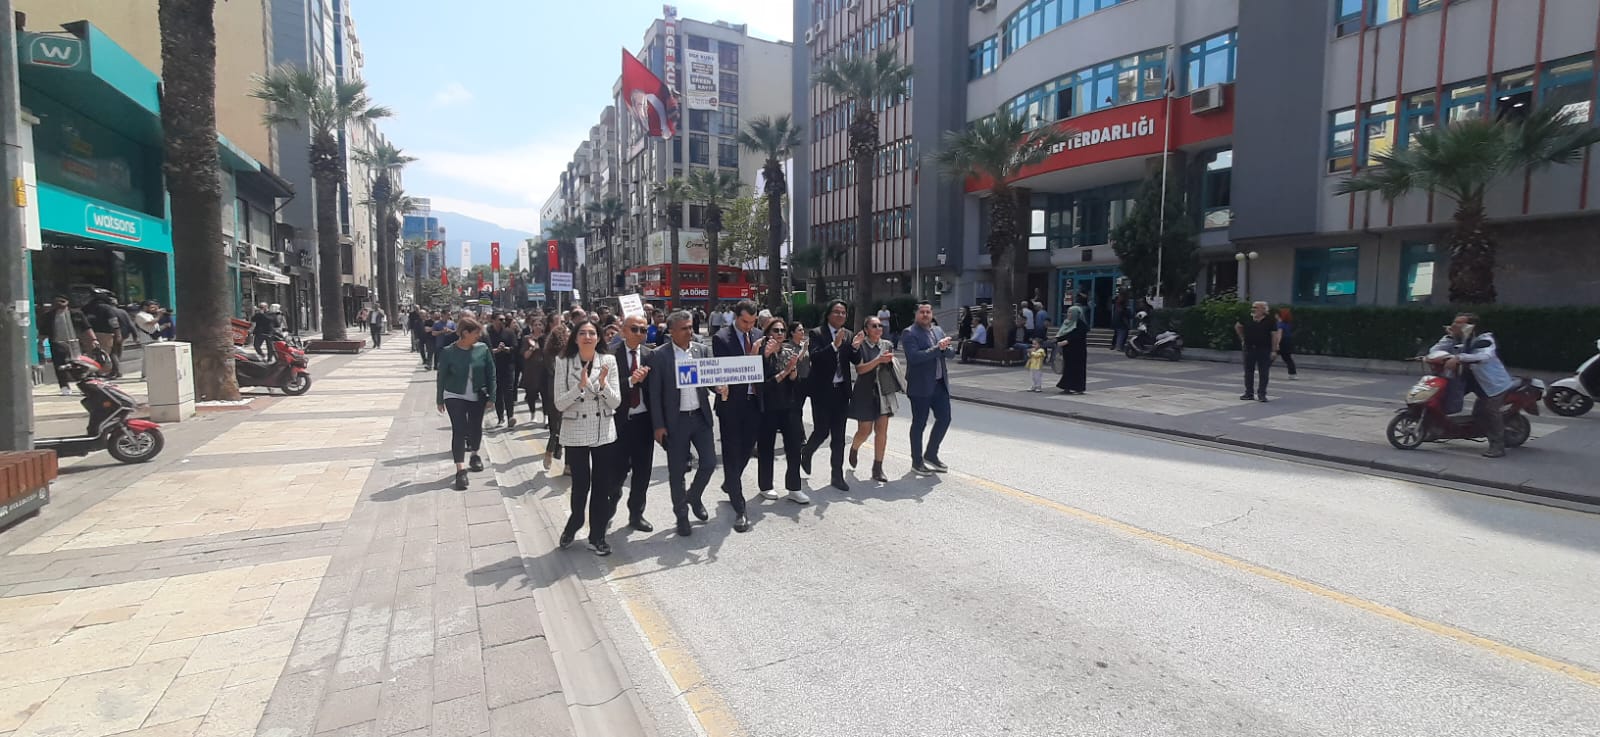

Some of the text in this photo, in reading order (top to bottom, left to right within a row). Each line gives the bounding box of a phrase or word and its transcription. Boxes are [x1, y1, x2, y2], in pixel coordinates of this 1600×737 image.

[665, 26, 676, 57] EGE
[93, 212, 136, 235] watsons
[700, 368, 723, 376] SERBEST
[700, 376, 714, 385] MALİ
